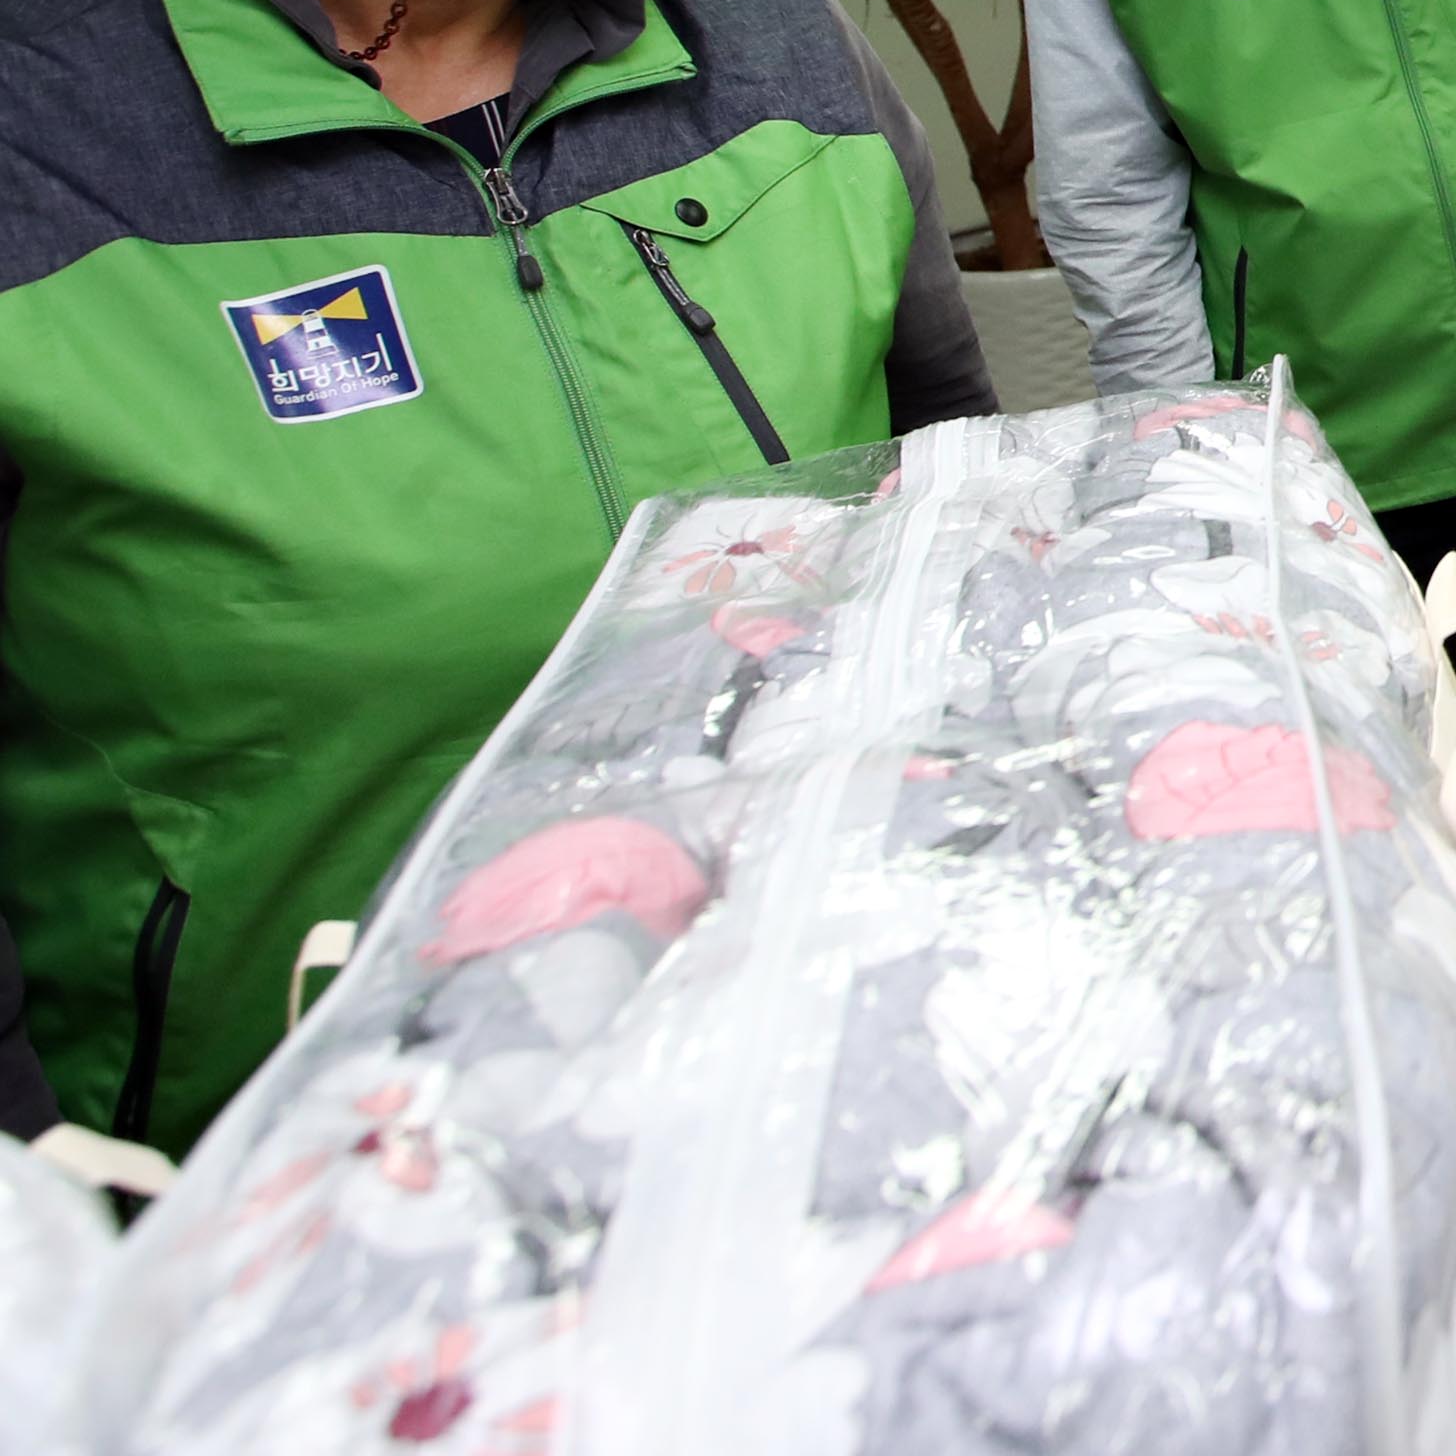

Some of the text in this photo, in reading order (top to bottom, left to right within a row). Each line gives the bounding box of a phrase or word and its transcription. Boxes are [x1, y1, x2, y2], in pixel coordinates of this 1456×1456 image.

[267, 333, 393, 392] 희망지기
[274, 371, 399, 405] Guardian Of Hope
